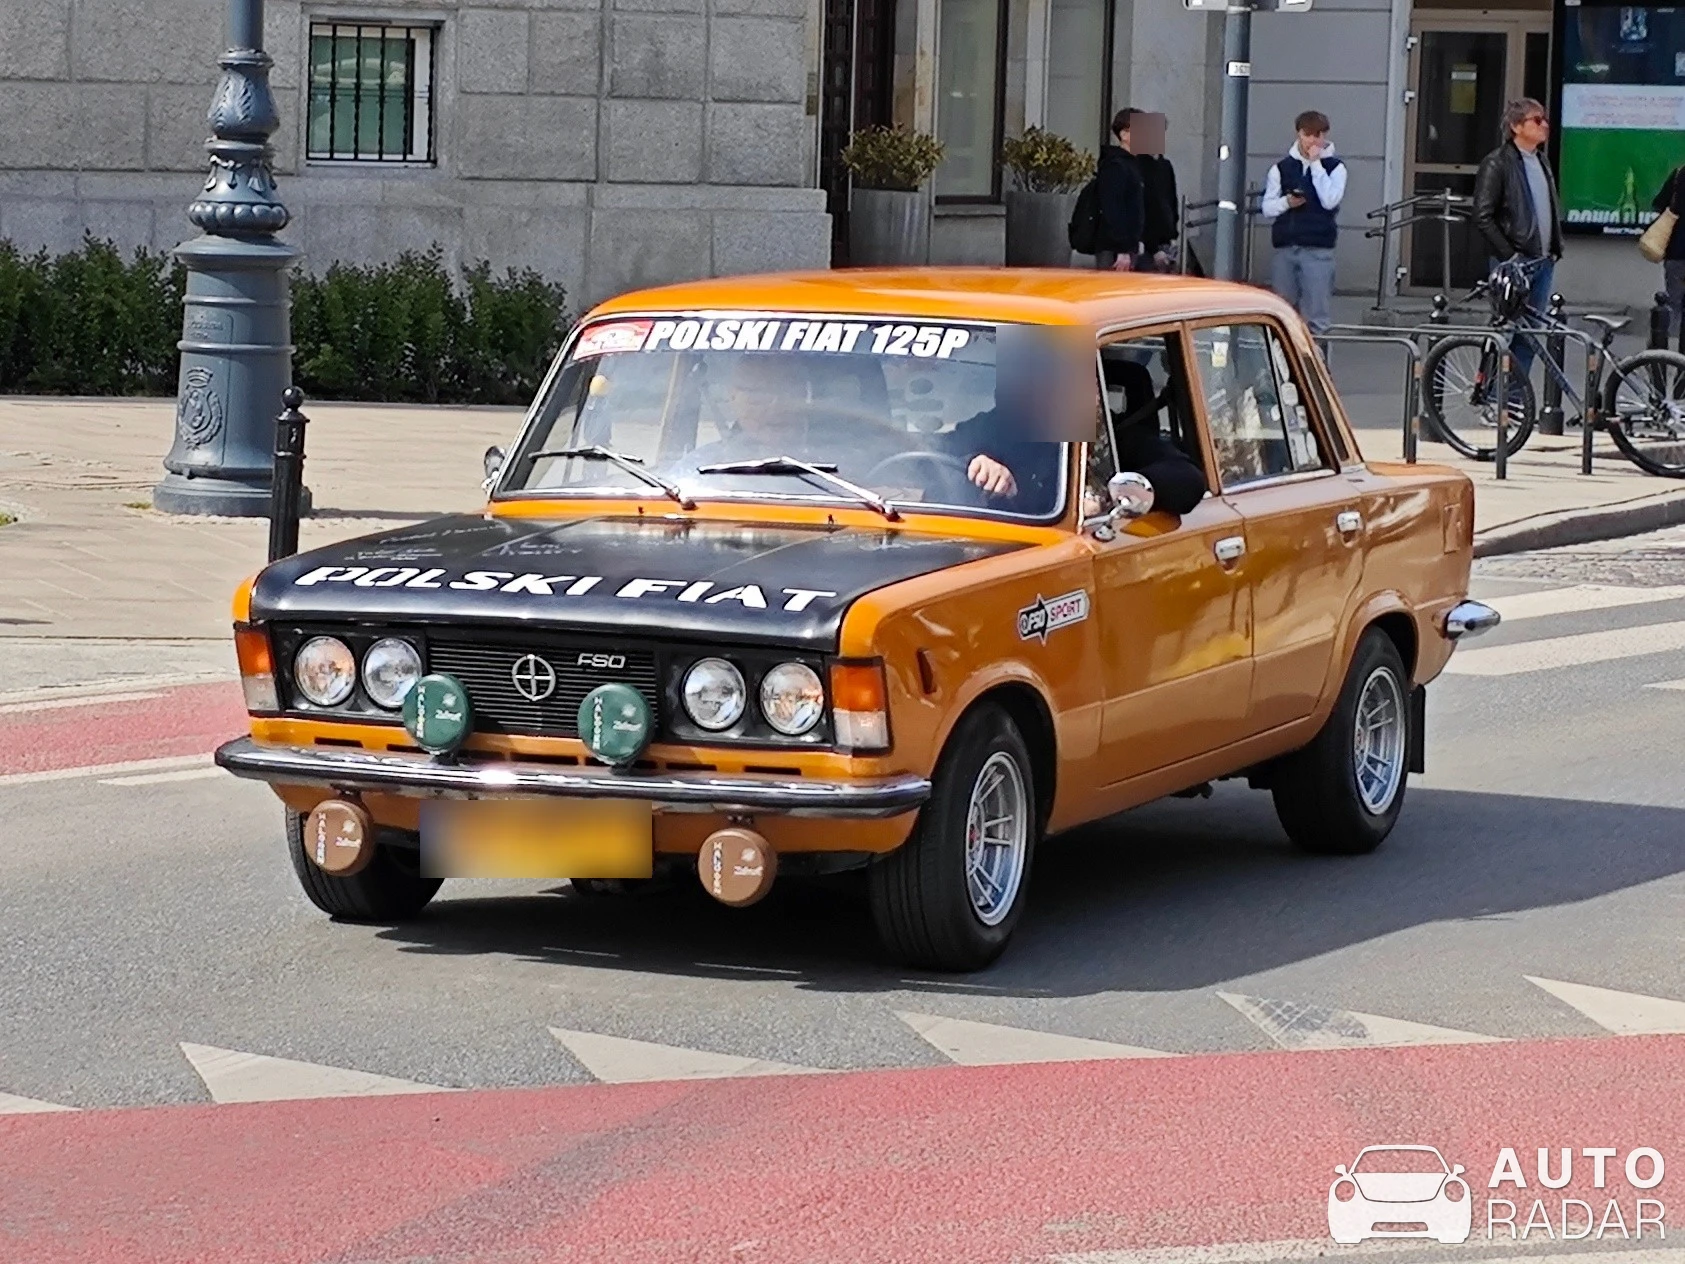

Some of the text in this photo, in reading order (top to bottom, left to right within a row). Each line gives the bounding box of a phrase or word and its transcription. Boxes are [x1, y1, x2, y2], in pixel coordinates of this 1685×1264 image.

[644, 320, 781, 350] POLSKI
[780, 321, 868, 352] FIAT
[871, 324, 970, 358] 125P
[295, 566, 838, 612] POLSKI FIAT
[1050, 598, 1082, 622] SPORT
[577, 653, 626, 668] FSO
